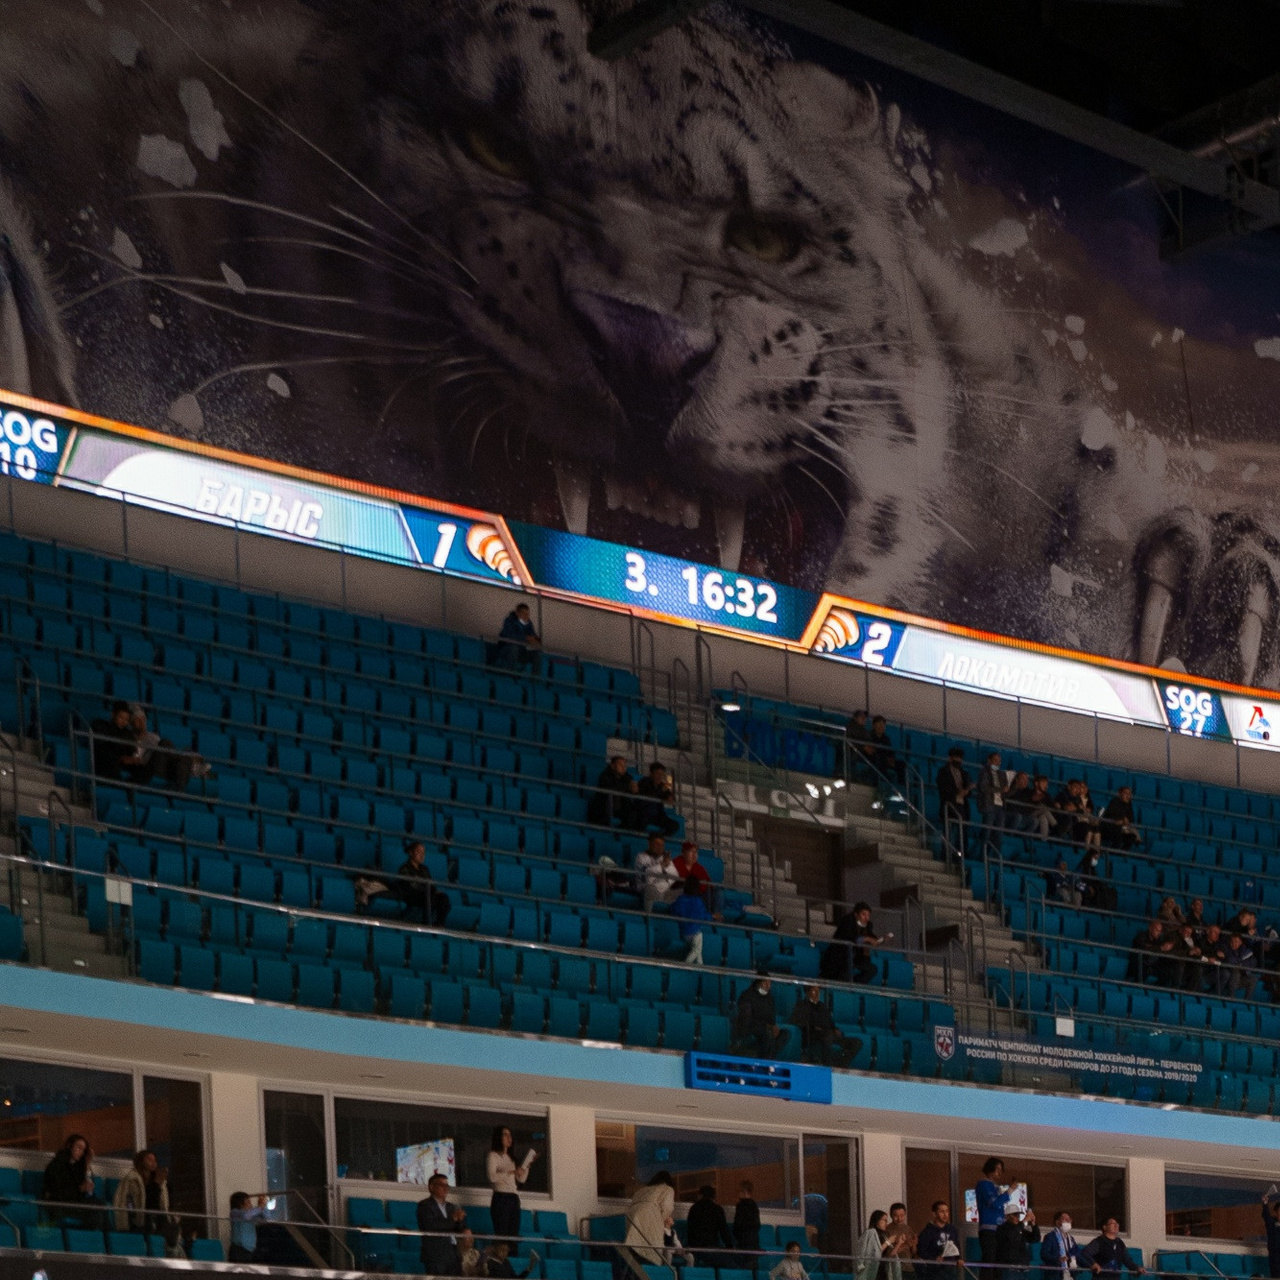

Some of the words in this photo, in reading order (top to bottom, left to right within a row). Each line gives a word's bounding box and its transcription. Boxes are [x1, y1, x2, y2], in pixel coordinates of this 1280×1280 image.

[0, 408, 58, 453] OG
[196, 479, 323, 538] БАРЫС
[433, 522, 457, 568] 1
[625, 552, 659, 596] 3.
[681, 566, 777, 623] 16:32
[862, 622, 892, 665] 2
[937, 652, 1081, 702] ЛОКОМОТИВ
[1166, 685, 1213, 716] SOG
[1180, 712, 1206, 737] 27
[958, 1035, 998, 1048] ПАРИМАТЧ
[999, 1040, 1042, 1053] ЧЕМПИОНАТ
[1043, 1045, 1093, 1059] МОЛОДЕЖНОЙ
[1095, 1052, 1136, 1064] ХОККЕЙНОЙ
[1137, 1058, 1155, 1066] ЛИГИ
[1160, 1059, 1203, 1072] ПЕРВЕНСТВО
[967, 1048, 996, 1059] РОССИИ
[997, 1052, 1007, 1061] ПО
[1008, 1053, 1039, 1065] ХОККЕЮ
[1040, 1057, 1063, 1067] СРЕДИ
[1064, 1060, 1099, 1072] ЮНИОРОВ
[1100, 1063, 1110, 1074] ДО
[1111, 1065, 1118, 1074] 21
[1119, 1066, 1136, 1076] ГОДА
[1137, 1068, 1163, 1078] СЕЗОНА
[1164, 1071, 1198, 1082] 2019/2020
